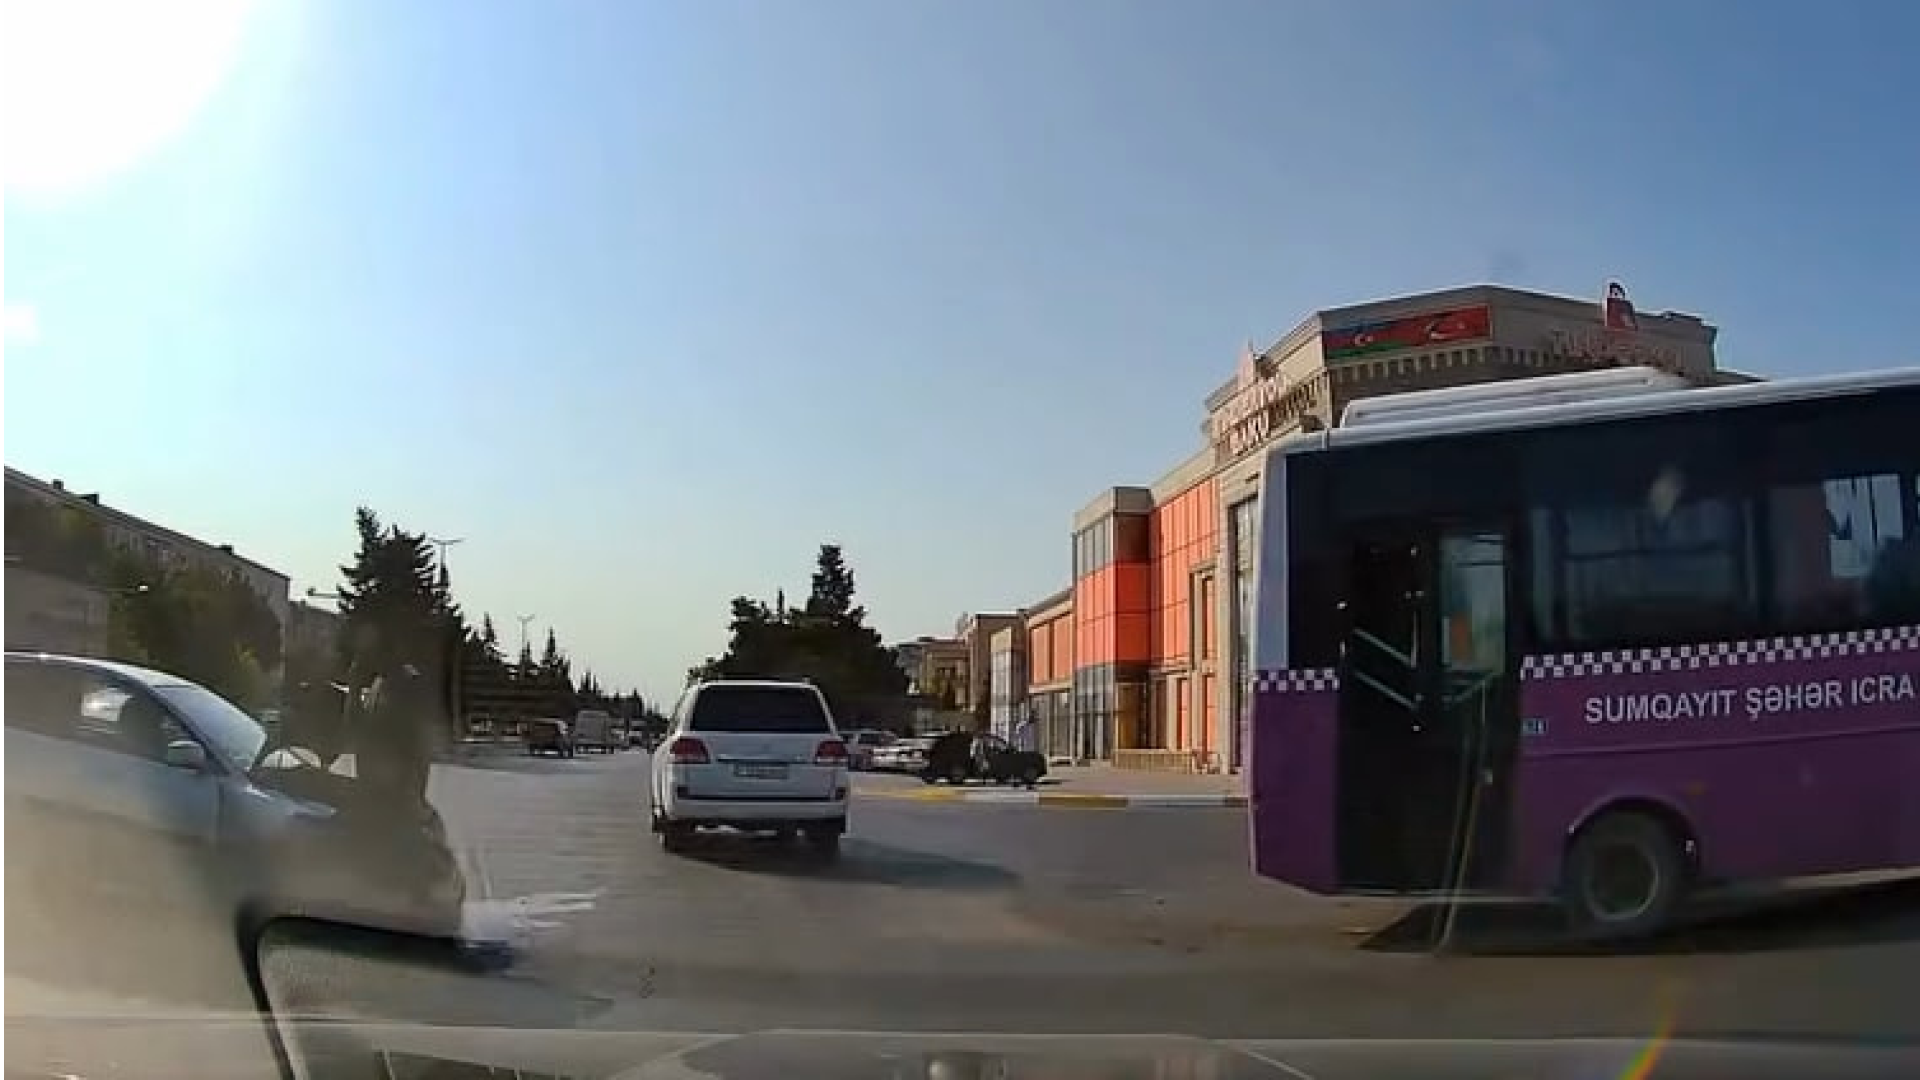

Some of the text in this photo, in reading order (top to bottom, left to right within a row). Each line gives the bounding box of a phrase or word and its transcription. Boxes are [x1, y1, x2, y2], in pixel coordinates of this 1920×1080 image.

[1585, 674, 1914, 723] SUMQAYIT ŞƏHƏR ICRA
